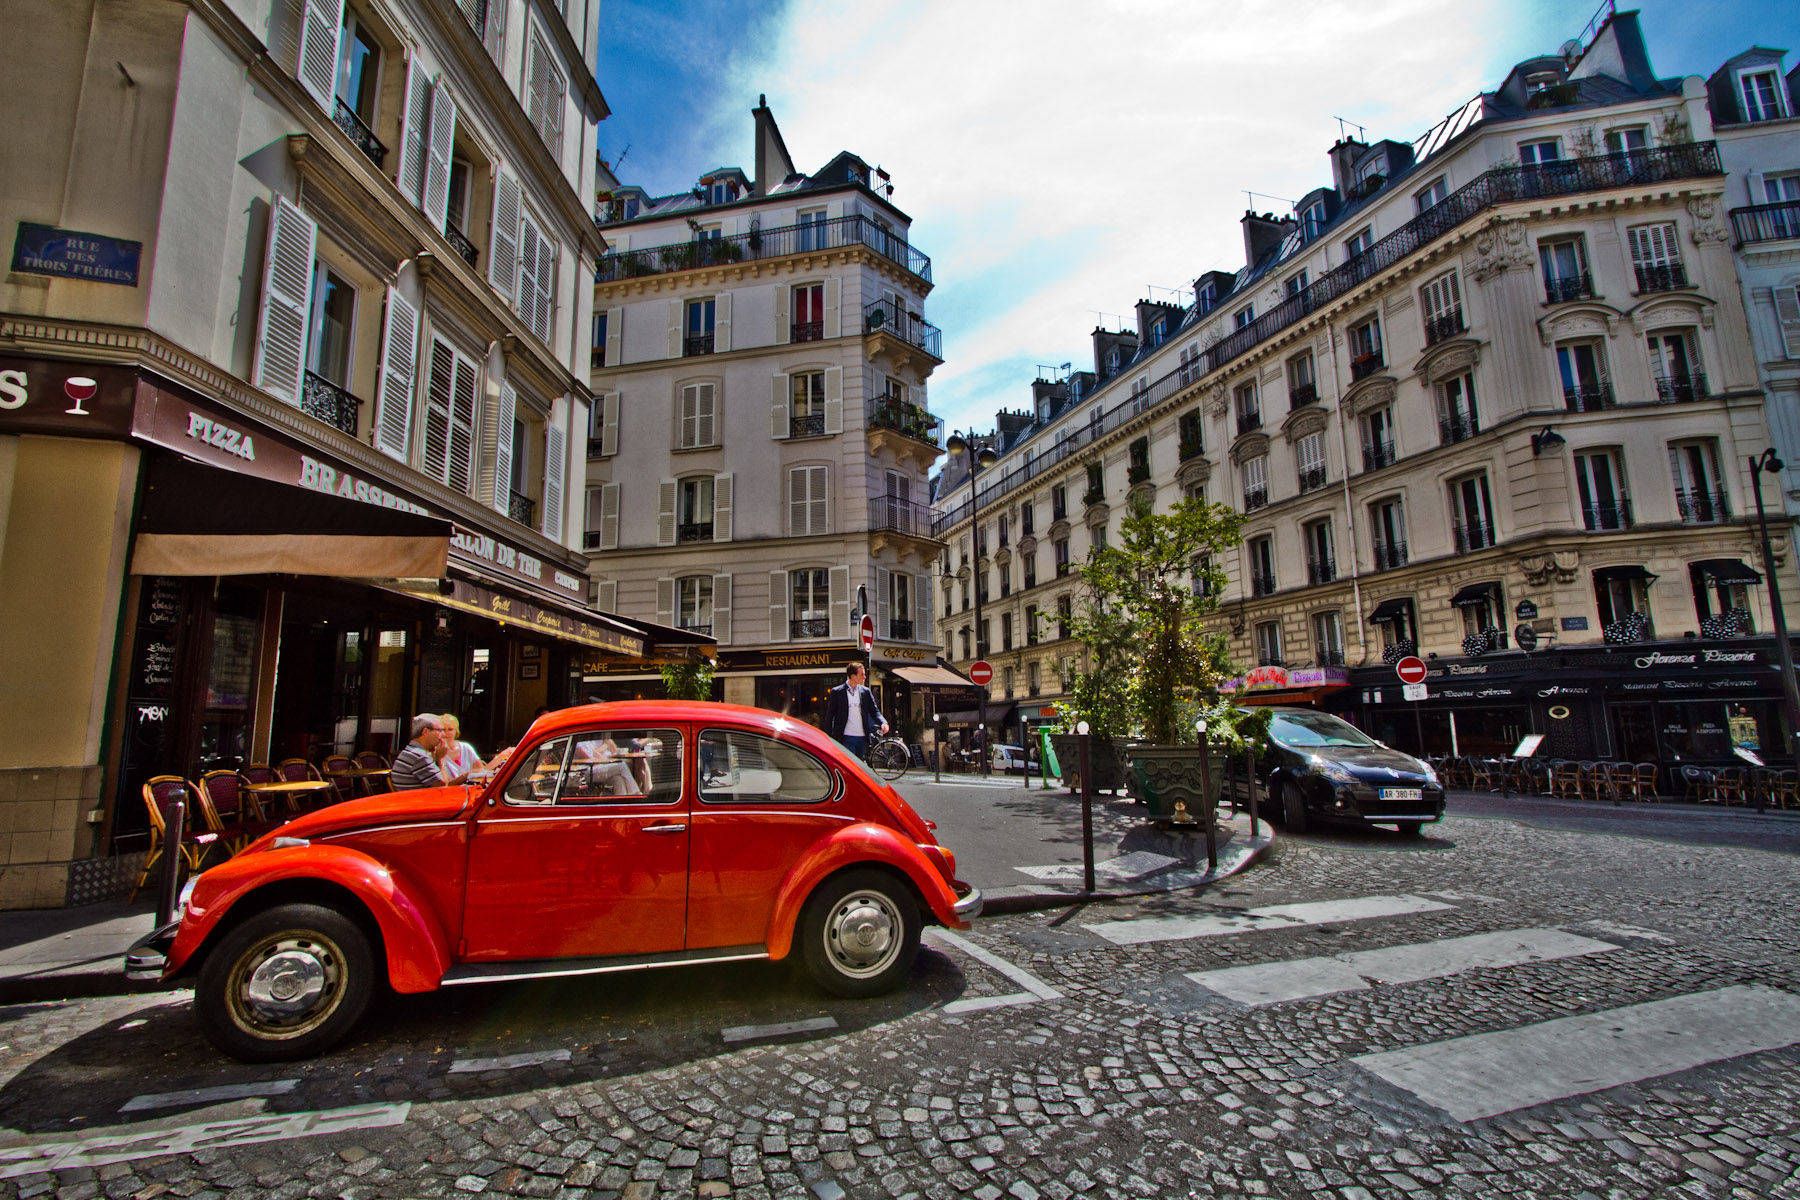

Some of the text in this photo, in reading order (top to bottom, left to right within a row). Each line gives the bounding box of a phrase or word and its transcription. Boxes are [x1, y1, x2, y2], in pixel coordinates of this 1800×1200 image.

[66, 238, 101, 252] RUE
[23, 256, 69, 273] TROIS
[66, 250, 96, 263] DES
[187, 411, 256, 461] PIZZA
[496, 542, 516, 569] DE
[492, 595, 511, 612] Grill
[765, 653, 832, 667] RESTAURANT
[1633, 648, 1757, 669] Florenza Pizzeria
